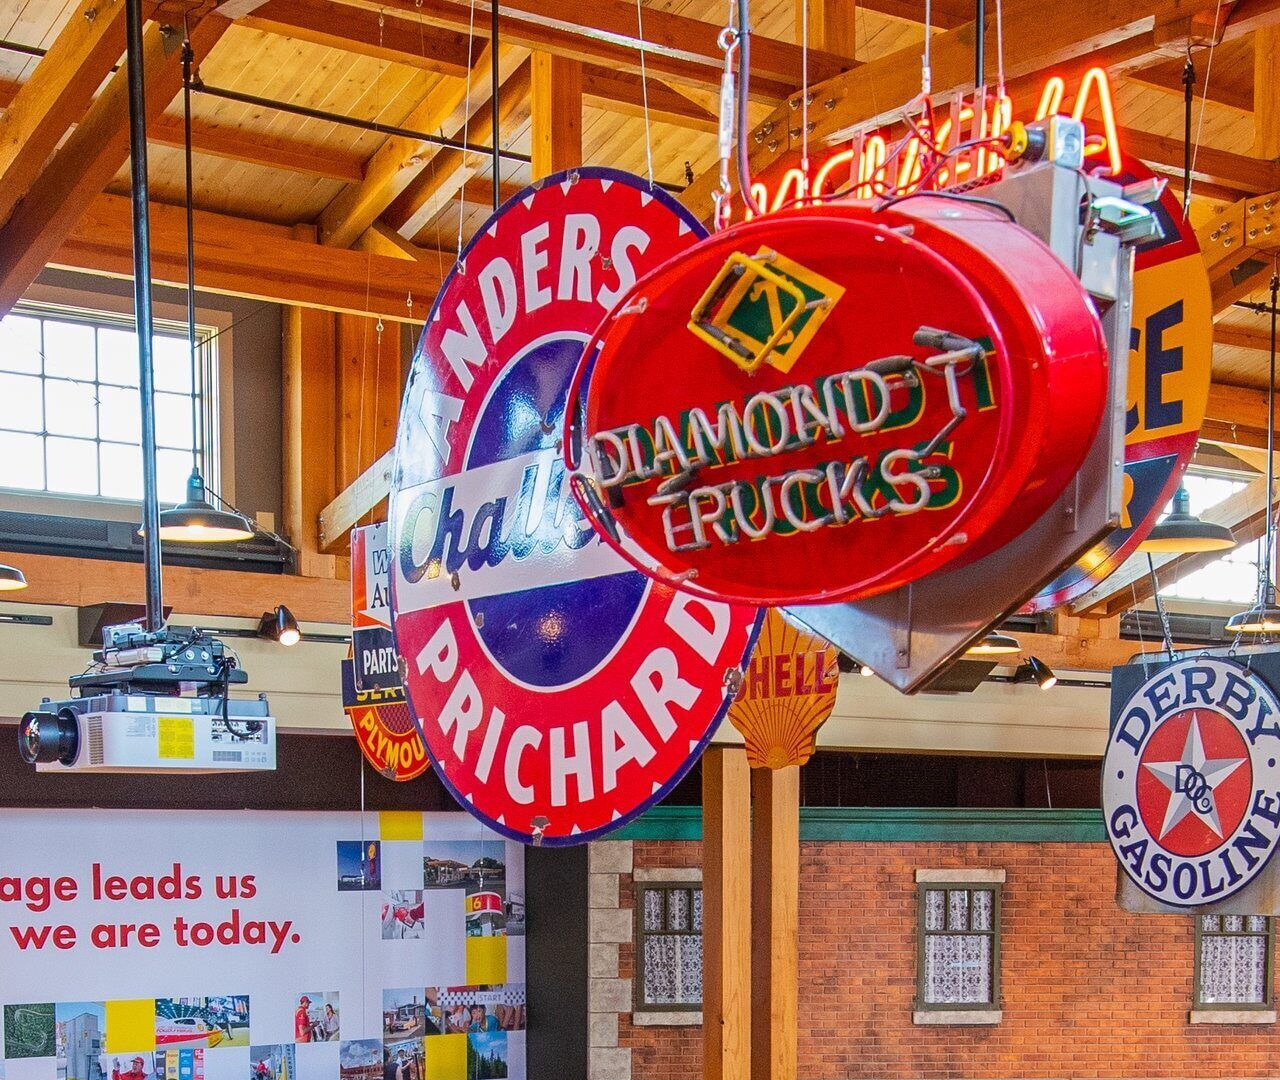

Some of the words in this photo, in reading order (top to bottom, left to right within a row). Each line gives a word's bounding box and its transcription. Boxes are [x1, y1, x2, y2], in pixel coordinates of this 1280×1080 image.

[588, 368, 916, 487] DIAMOND
[648, 446, 958, 552] TRUCKS
[363, 646, 398, 676] PARTS
[415, 588, 733, 808] PRICHARD
[359, 708, 425, 770] PLYMOU
[92, 863, 202, 900] leads
[215, 873, 257, 900] us
[9, 925, 76, 950] we
[91, 923, 161, 948] are
[174, 908, 301, 954] today.
[479, 994, 501, 1002] START
